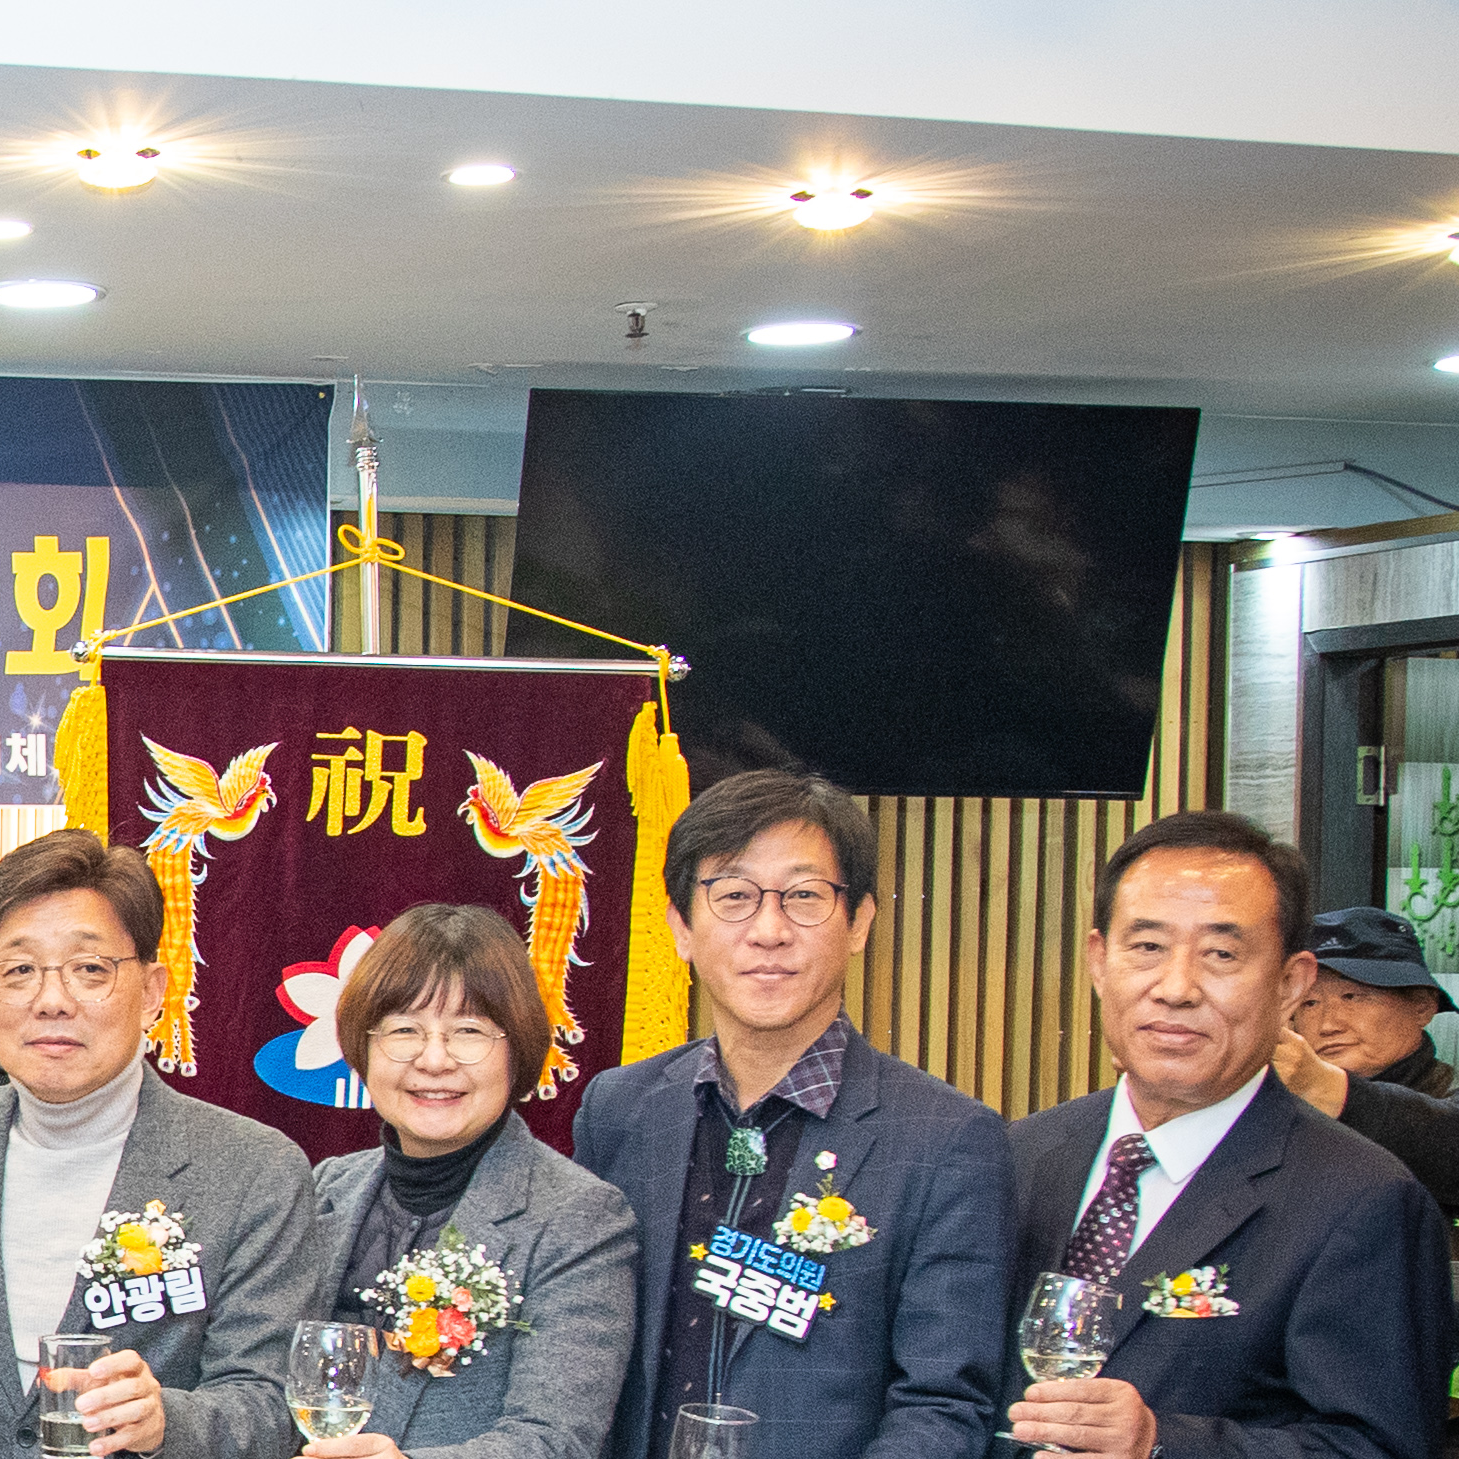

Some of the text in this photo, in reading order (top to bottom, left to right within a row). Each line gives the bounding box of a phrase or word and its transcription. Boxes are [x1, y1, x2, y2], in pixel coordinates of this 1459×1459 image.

[307, 726, 428, 837] 祝
[694, 1254, 820, 1339] 국중범
[710, 1225, 826, 1292] 경기도의원
[84, 1266, 207, 1329] 안광림
